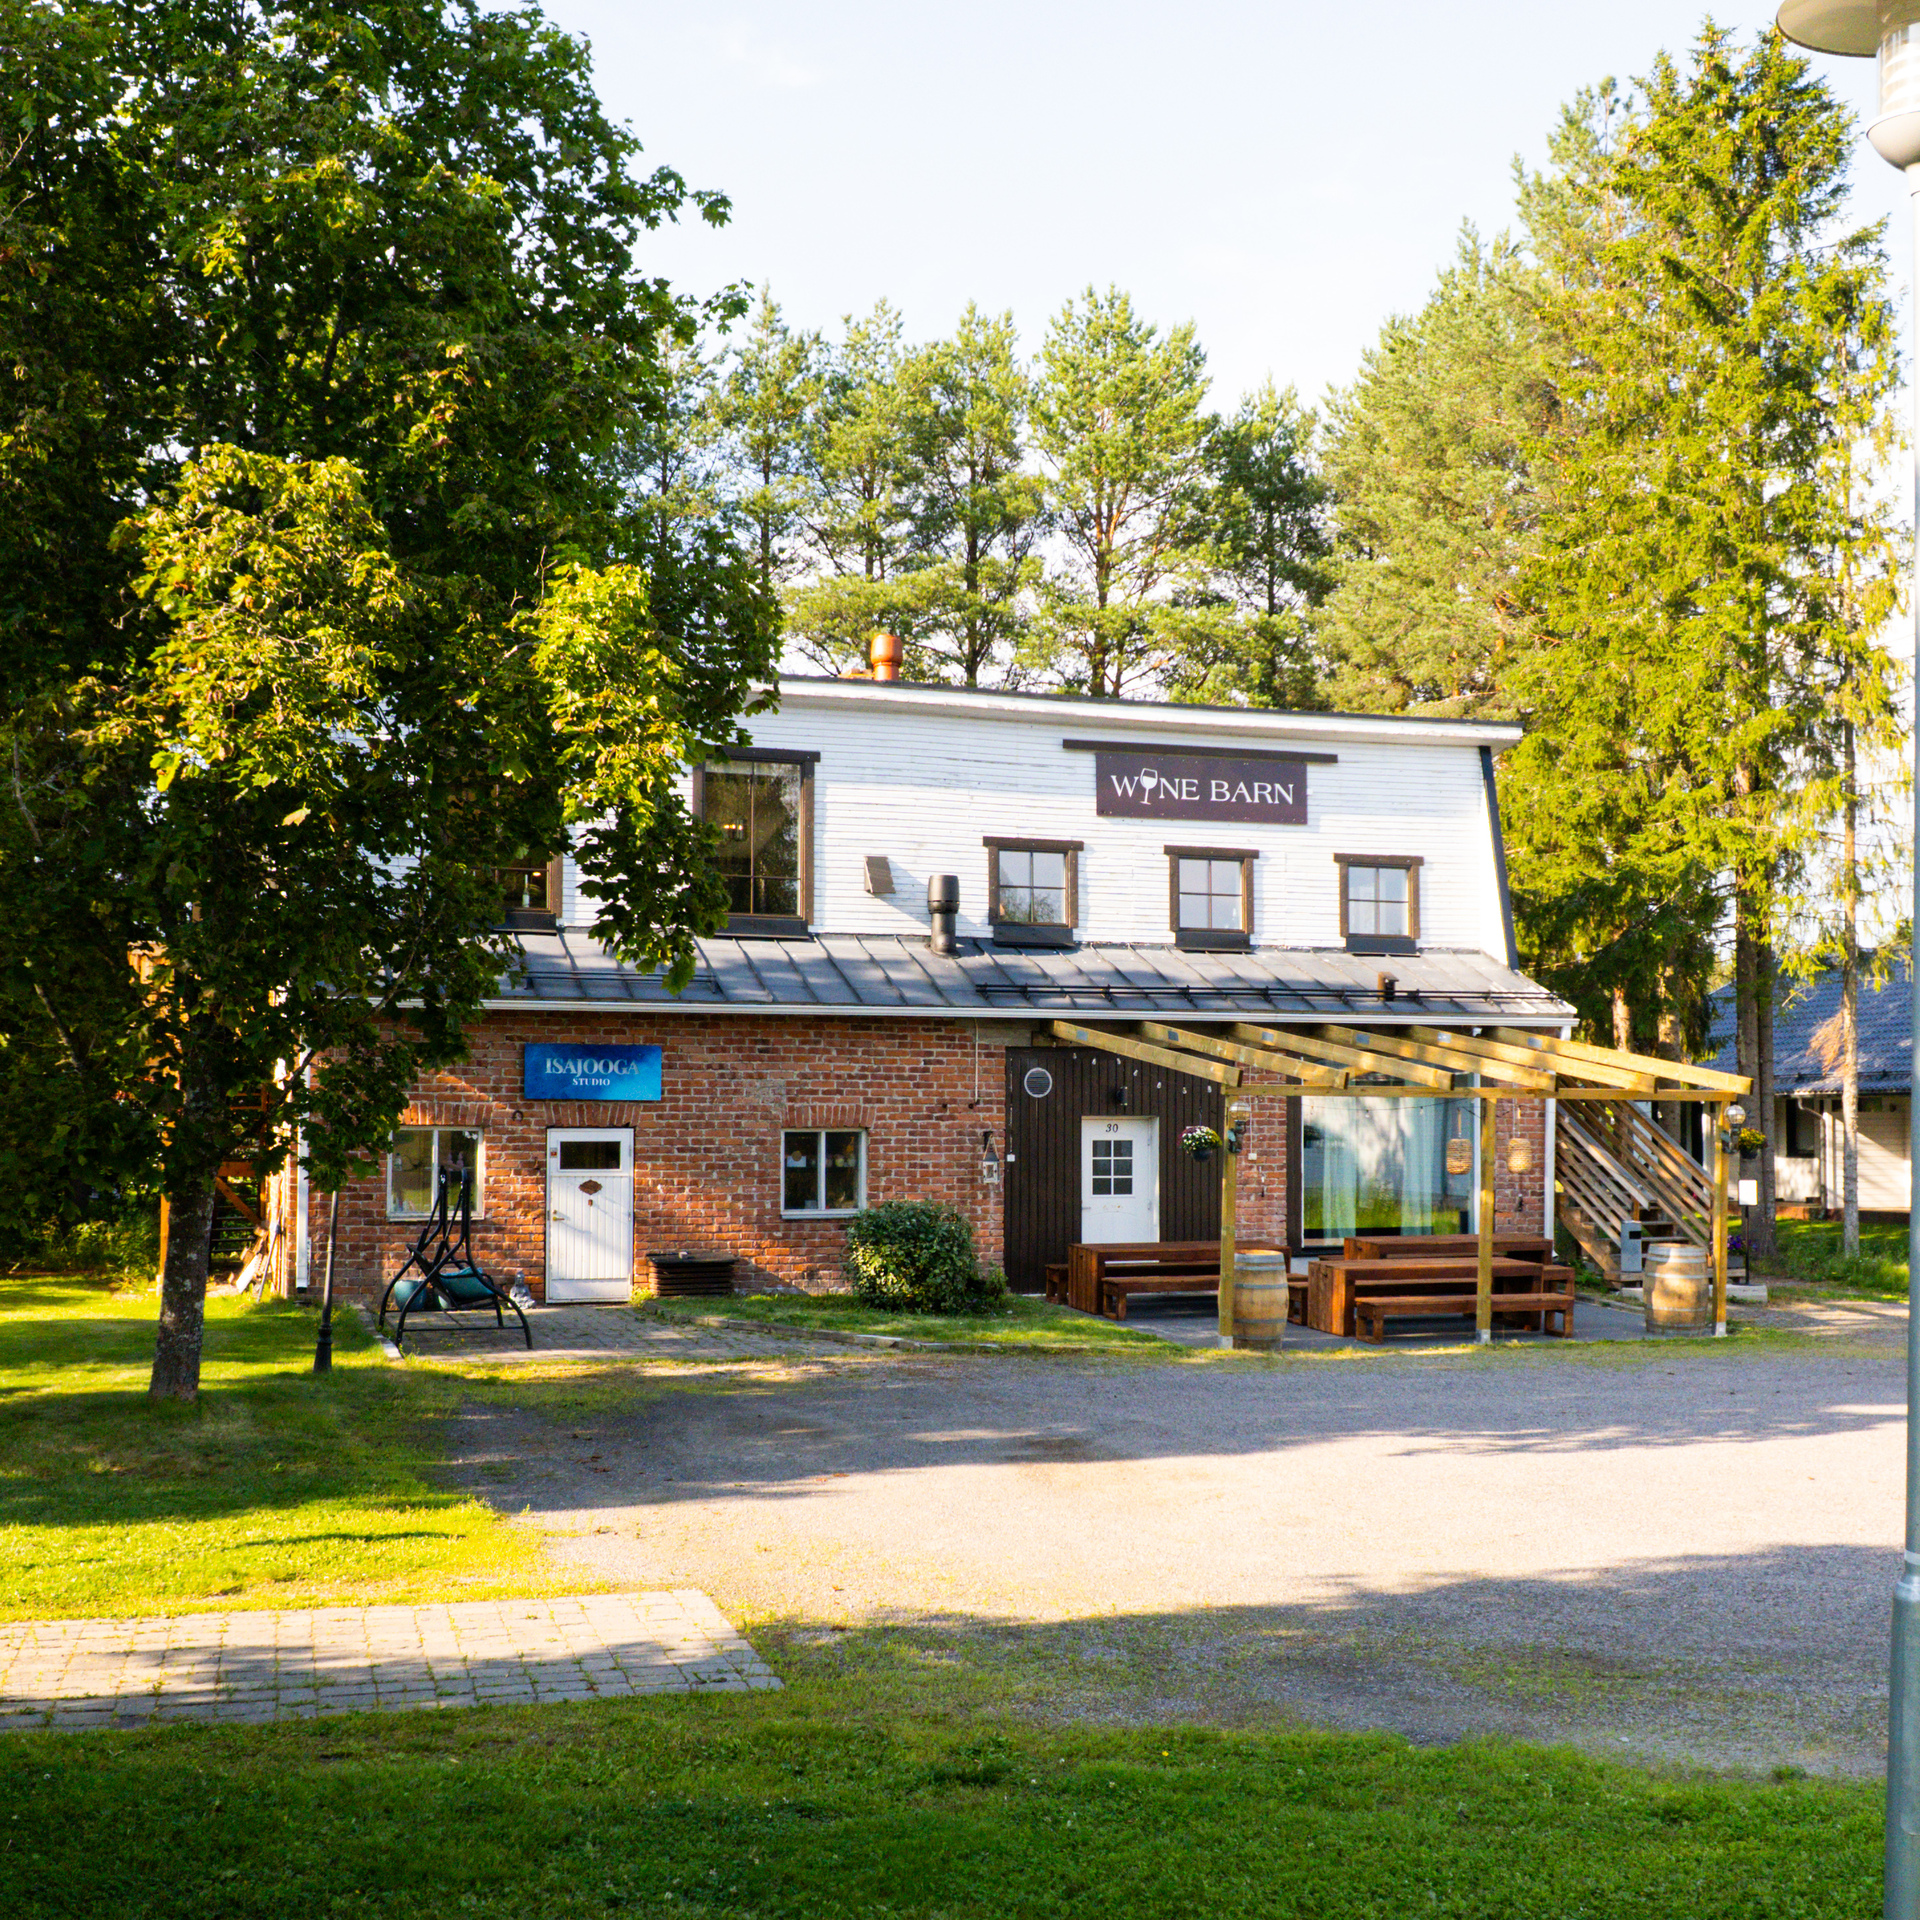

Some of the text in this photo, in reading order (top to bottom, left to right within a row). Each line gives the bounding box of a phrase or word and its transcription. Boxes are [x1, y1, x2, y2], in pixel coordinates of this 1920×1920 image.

[1210, 779, 1294, 805] BARN
[545, 1057, 640, 1077] ISAJOOGA
[572, 1077, 611, 1086] STUDIO
[1105, 1123, 1119, 1133] 30
